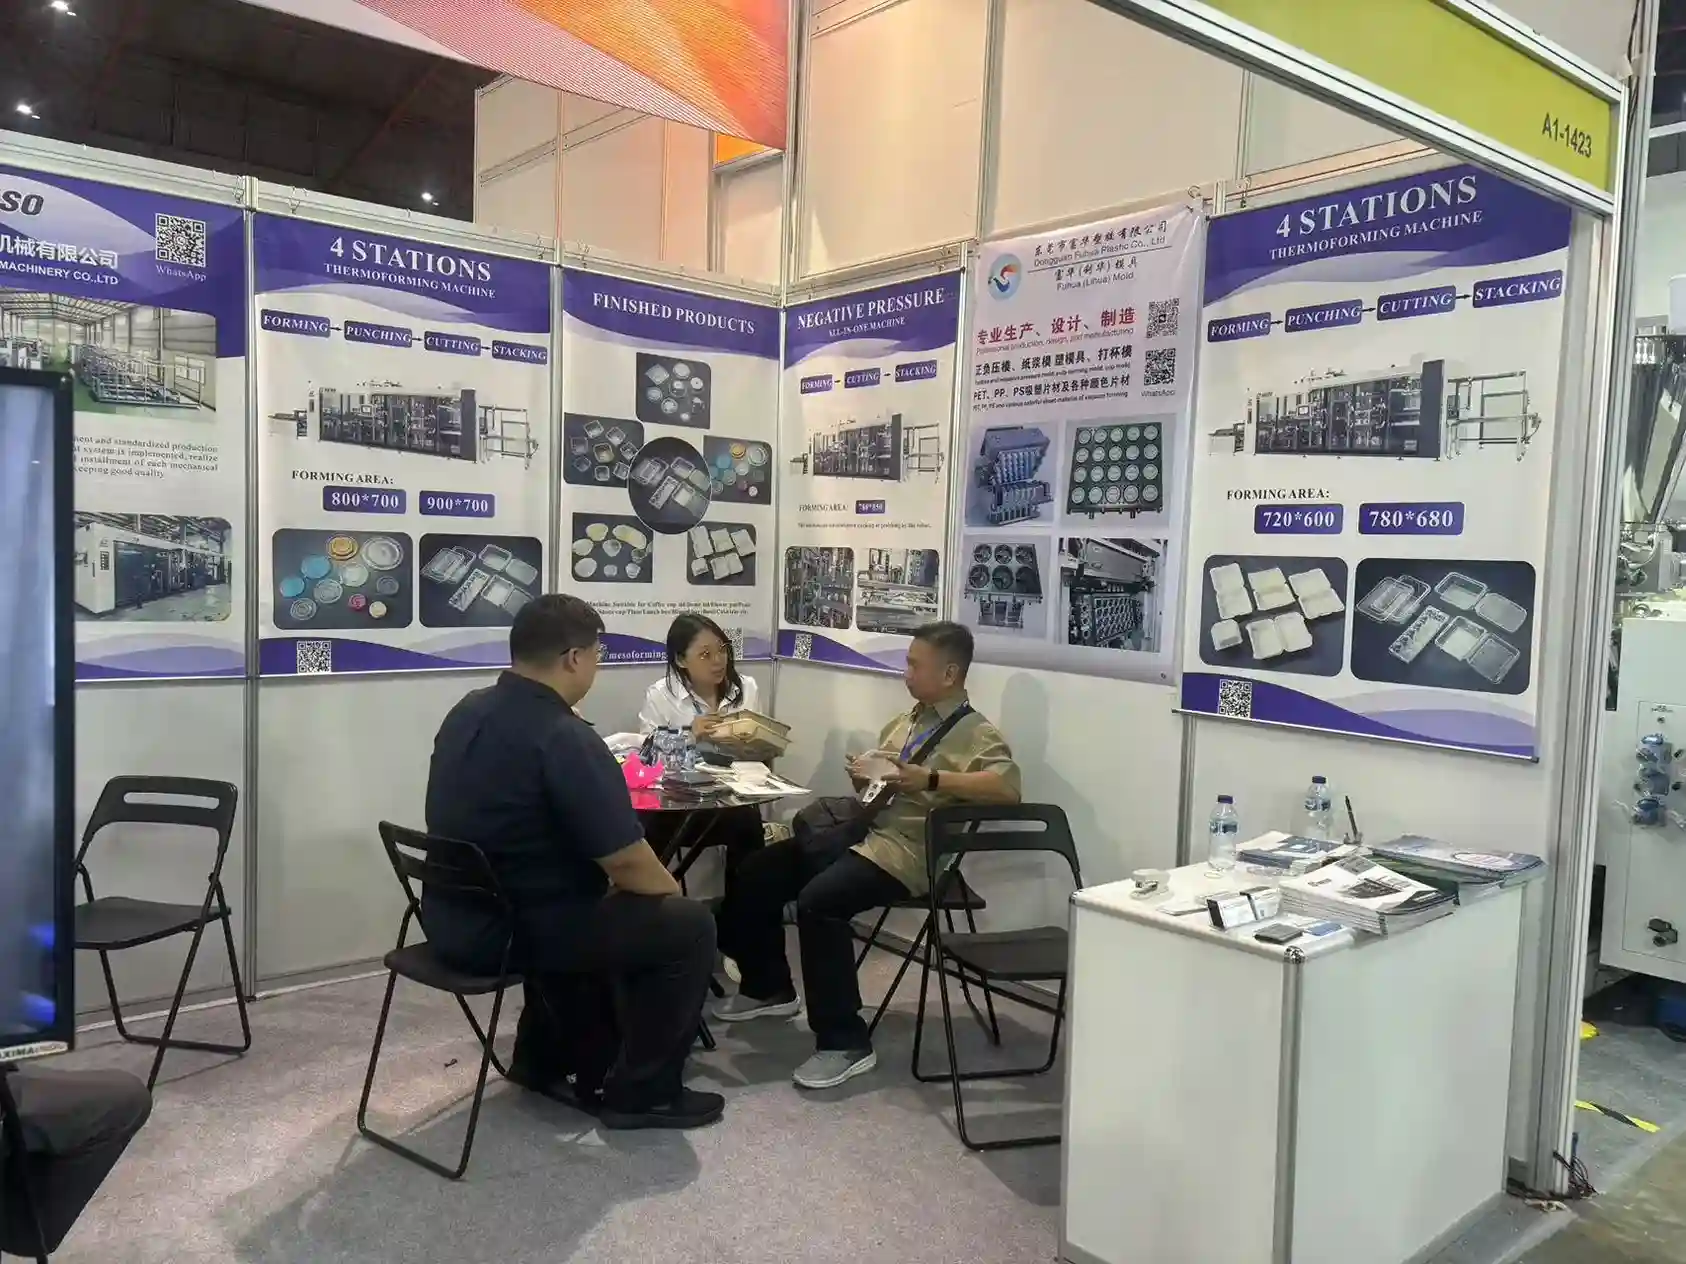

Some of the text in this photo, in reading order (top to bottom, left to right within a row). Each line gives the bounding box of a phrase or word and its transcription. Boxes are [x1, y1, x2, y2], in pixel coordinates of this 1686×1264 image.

[1542, 113, 1592, 159] A1-1423
[1276, 175, 1478, 238] 4 STATIONS
[1270, 210, 1483, 261] THERMOFORMING MACHINE
[1101, 243, 1129, 255] Plastic
[1151, 236, 1166, 246] Ltd
[330, 237, 491, 282] 4 STATIONS
[156, 264, 207, 282] WhatsApp
[324, 262, 496, 299] THERMOFORMING MACHINE
[1113, 272, 1134, 282] Mold
[1474, 277, 1562, 302] STACKING
[798, 287, 945, 330] NEGATIVE PRESSURE
[1379, 292, 1453, 314] CUTTING
[593, 292, 755, 334] FINISHED PRODUCTS
[1287, 305, 1362, 328] PUNCHING
[263, 315, 329, 333] FORMING
[869, 316, 906, 331] MACHINE
[1211, 318, 1270, 339] FORMING
[346, 326, 411, 345] PUNCHING
[427, 336, 478, 352] CUTTING
[493, 344, 547, 362] STACKING
[846, 370, 880, 385] CUTTING
[895, 363, 937, 378] STACKING
[801, 377, 833, 391] FORMING
[114, 438, 170, 449] standardized
[172, 443, 218, 454] production
[292, 470, 394, 485] FORMING AREA:
[1227, 488, 1330, 501] FORMING AREA:
